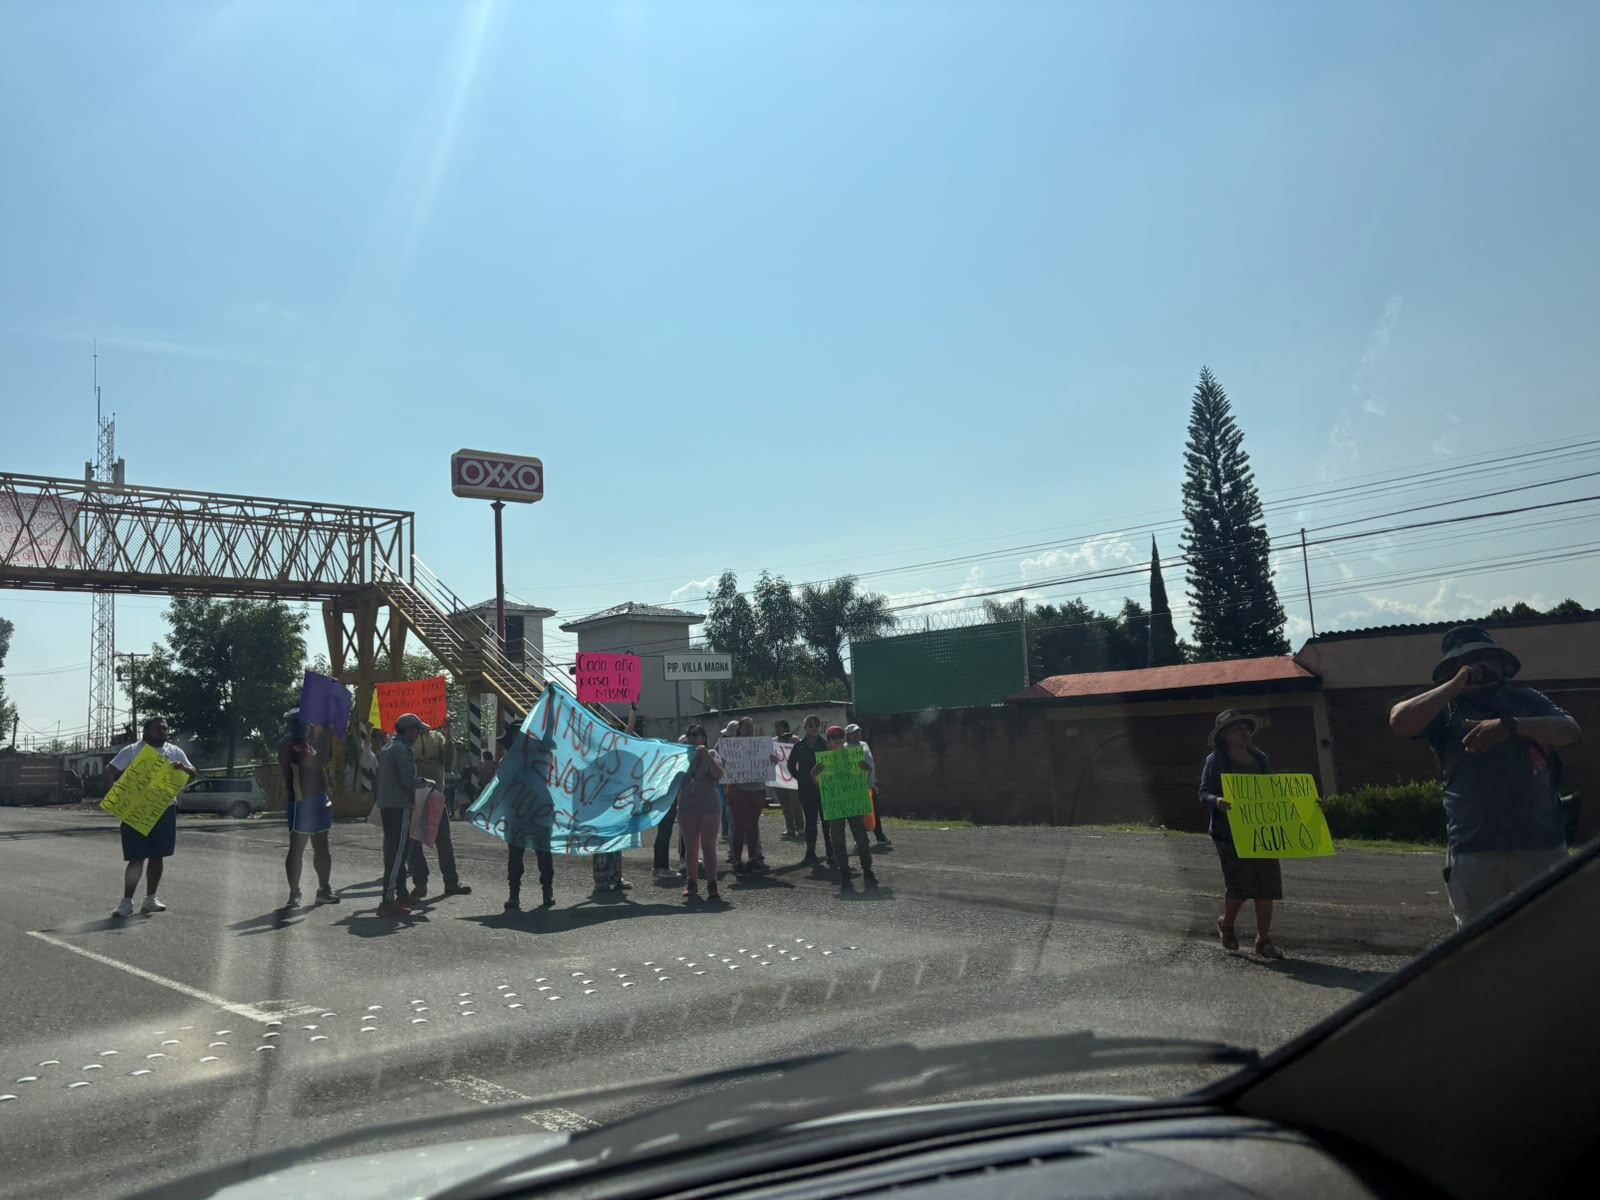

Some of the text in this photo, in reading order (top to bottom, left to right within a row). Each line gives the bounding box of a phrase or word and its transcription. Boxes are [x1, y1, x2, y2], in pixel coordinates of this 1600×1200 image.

[461, 460, 540, 490] OXXO
[667, 662, 729, 673] PIP. VILLA MAGNA
[580, 676, 609, 689] pasa
[1226, 775, 1315, 800] VILLA MAGNA
[1239, 800, 1302, 824] NECESITA
[1253, 825, 1293, 852] AGUA
